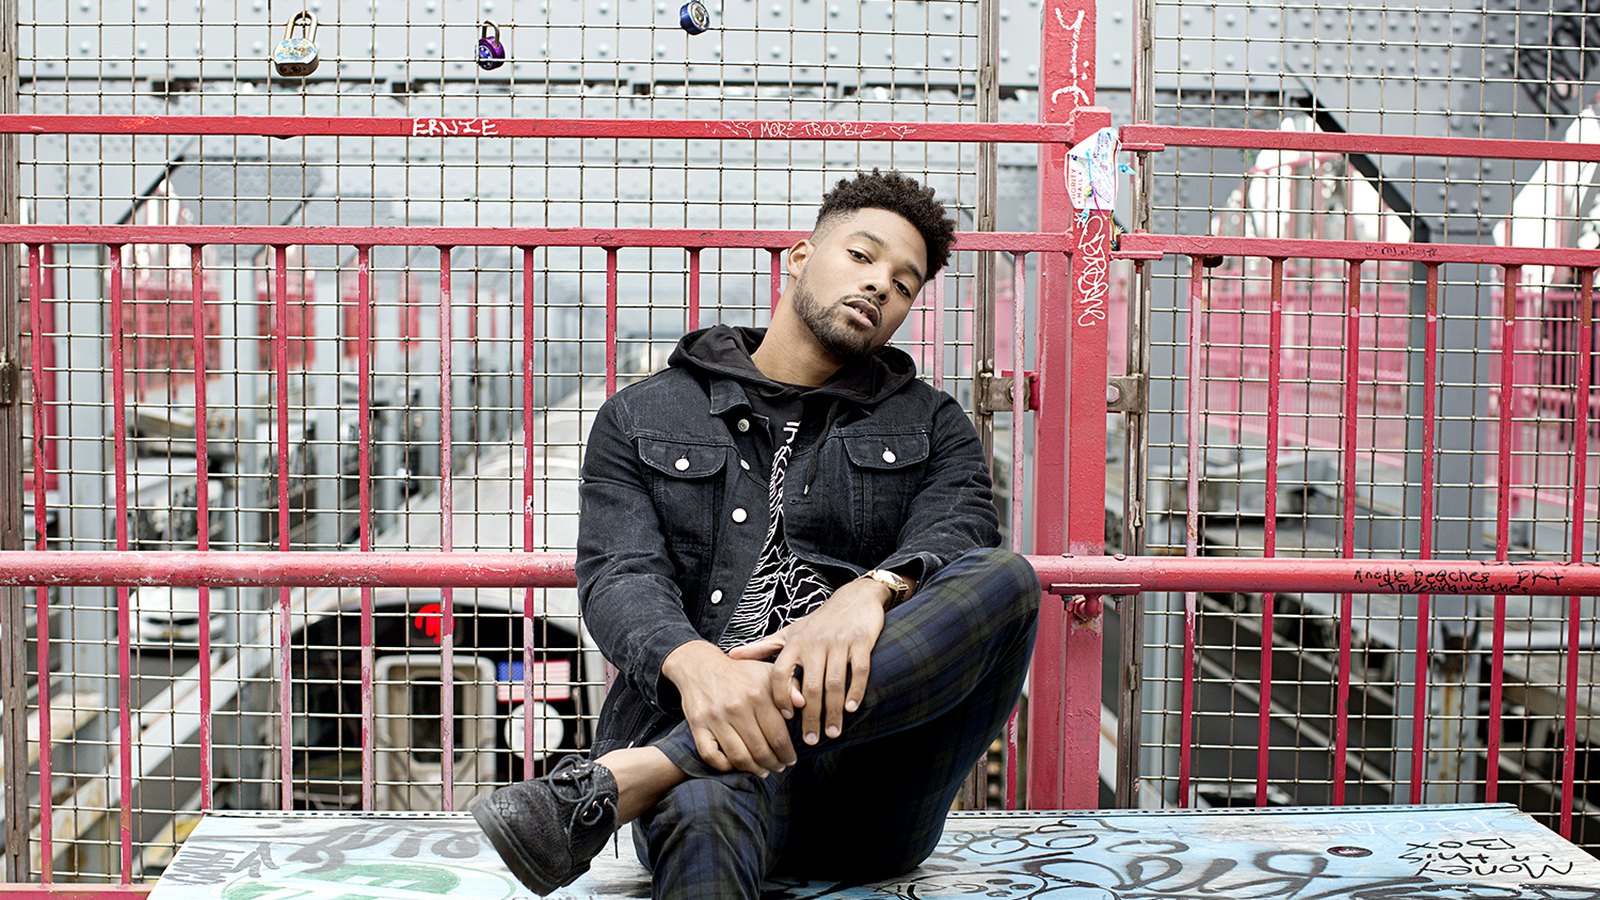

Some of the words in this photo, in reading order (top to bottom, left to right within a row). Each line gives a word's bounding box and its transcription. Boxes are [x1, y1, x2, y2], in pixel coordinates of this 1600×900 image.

[413, 117, 499, 136] ERNIE
[760, 120, 797, 138] MORE
[801, 121, 876, 139] TROUBLE
[1398, 852, 1489, 864] this
[1511, 853, 1553, 862] in
[1415, 859, 1573, 879] Money
